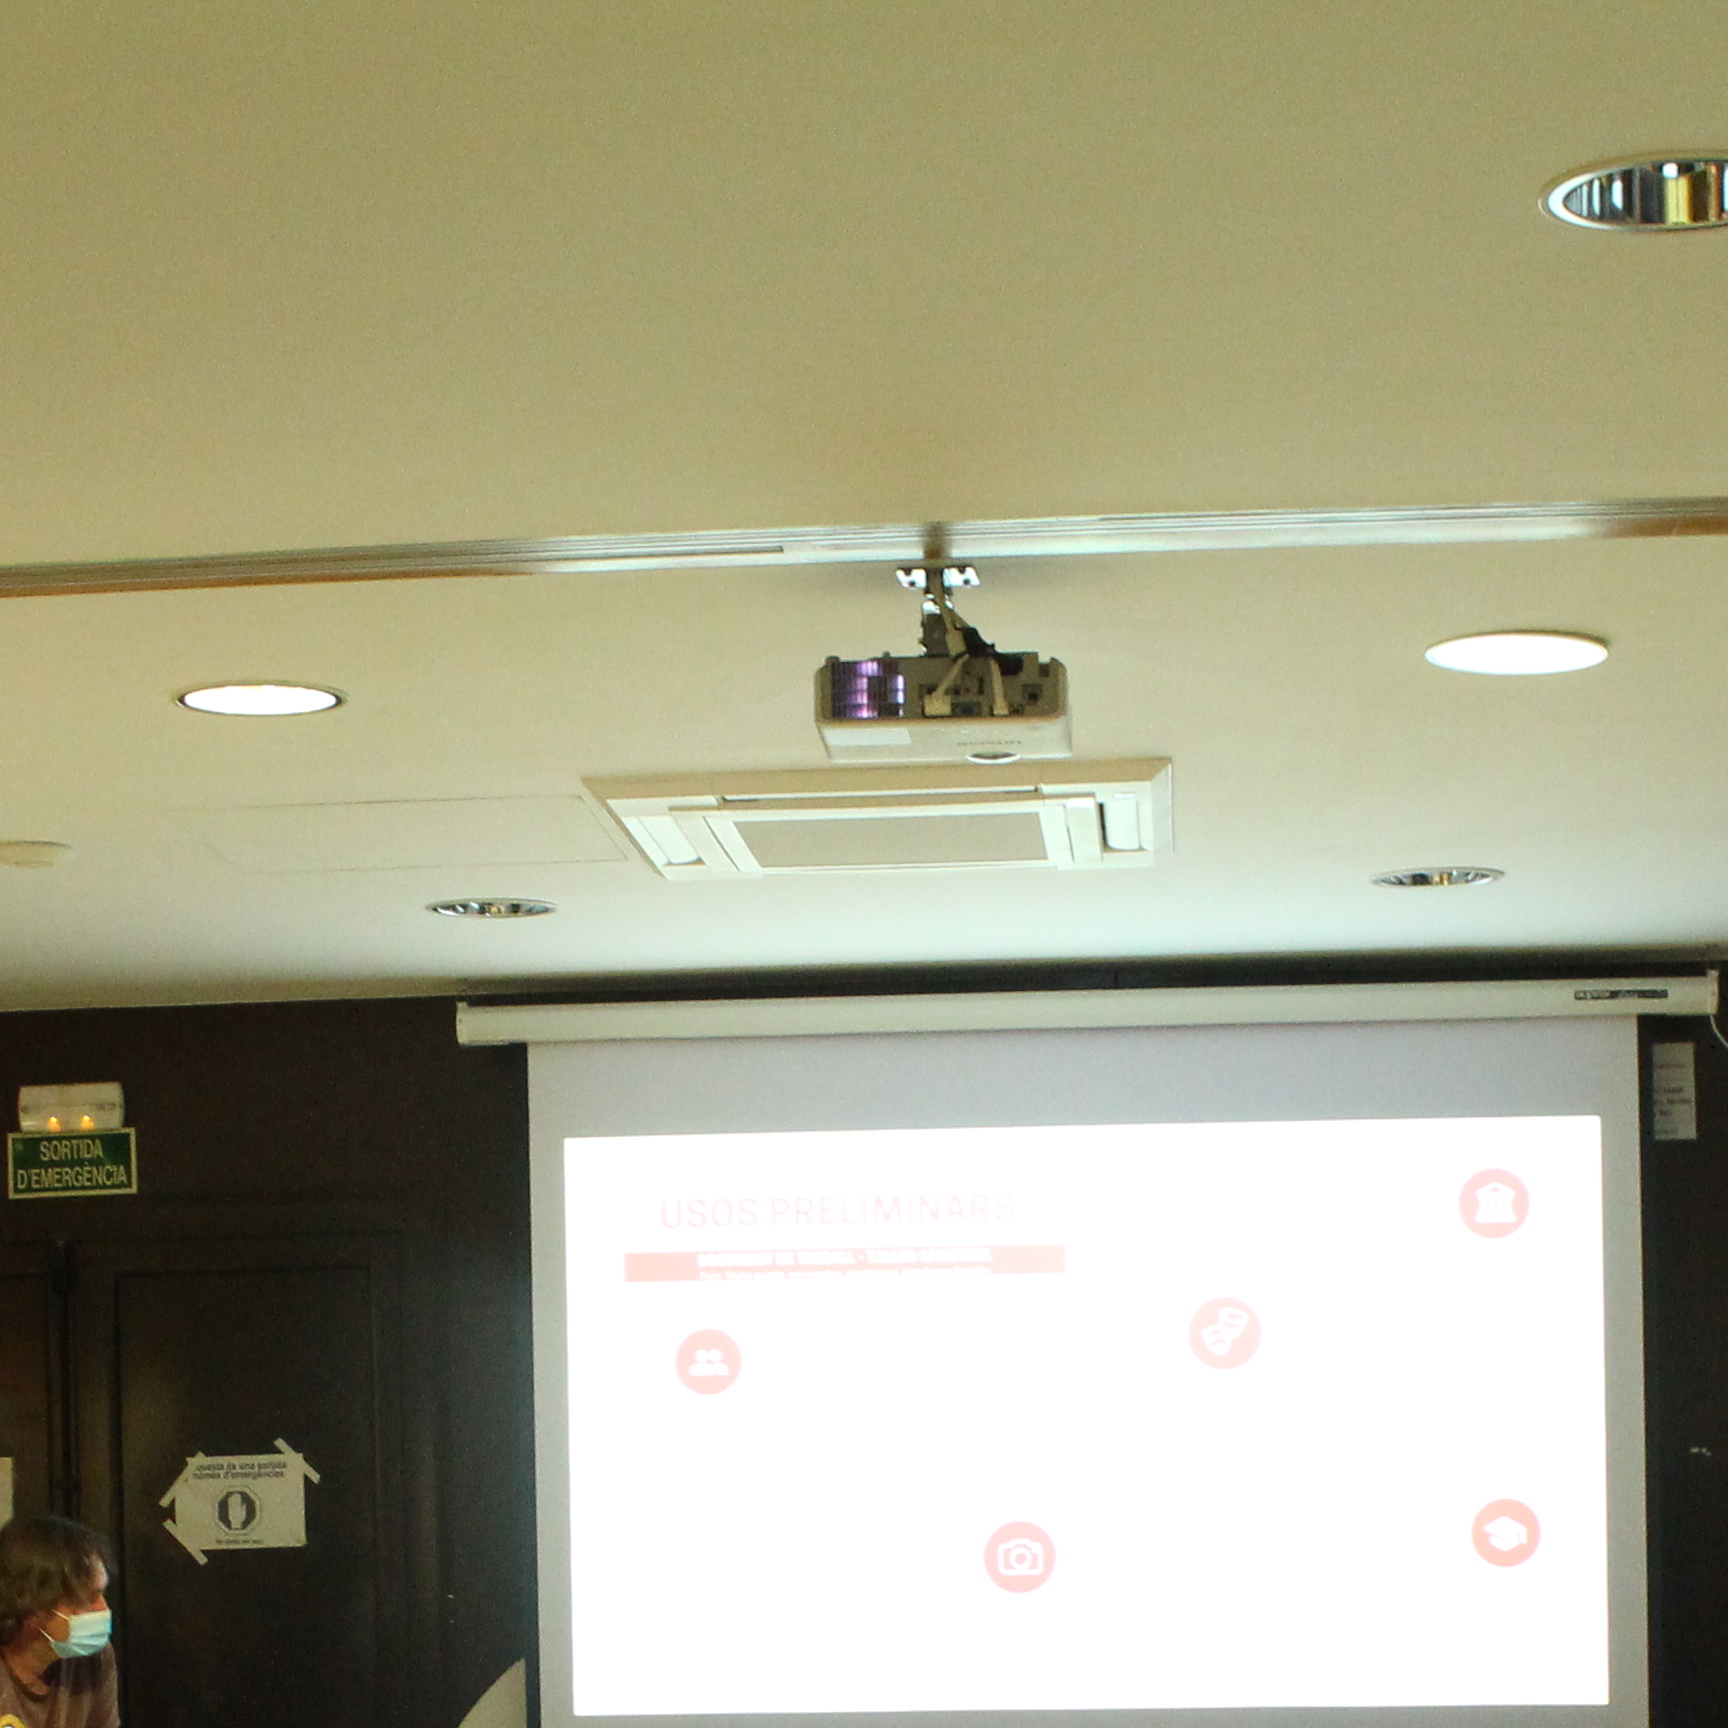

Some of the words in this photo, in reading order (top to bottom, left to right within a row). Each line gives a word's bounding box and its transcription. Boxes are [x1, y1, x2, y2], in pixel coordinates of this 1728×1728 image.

[39, 1138, 104, 1161] SORTIDA
[16, 1162, 129, 1189] D'EMERGÈNCIA
[660, 1198, 759, 1229] USOS
[770, 1192, 1015, 1225] PRELIMINARS
